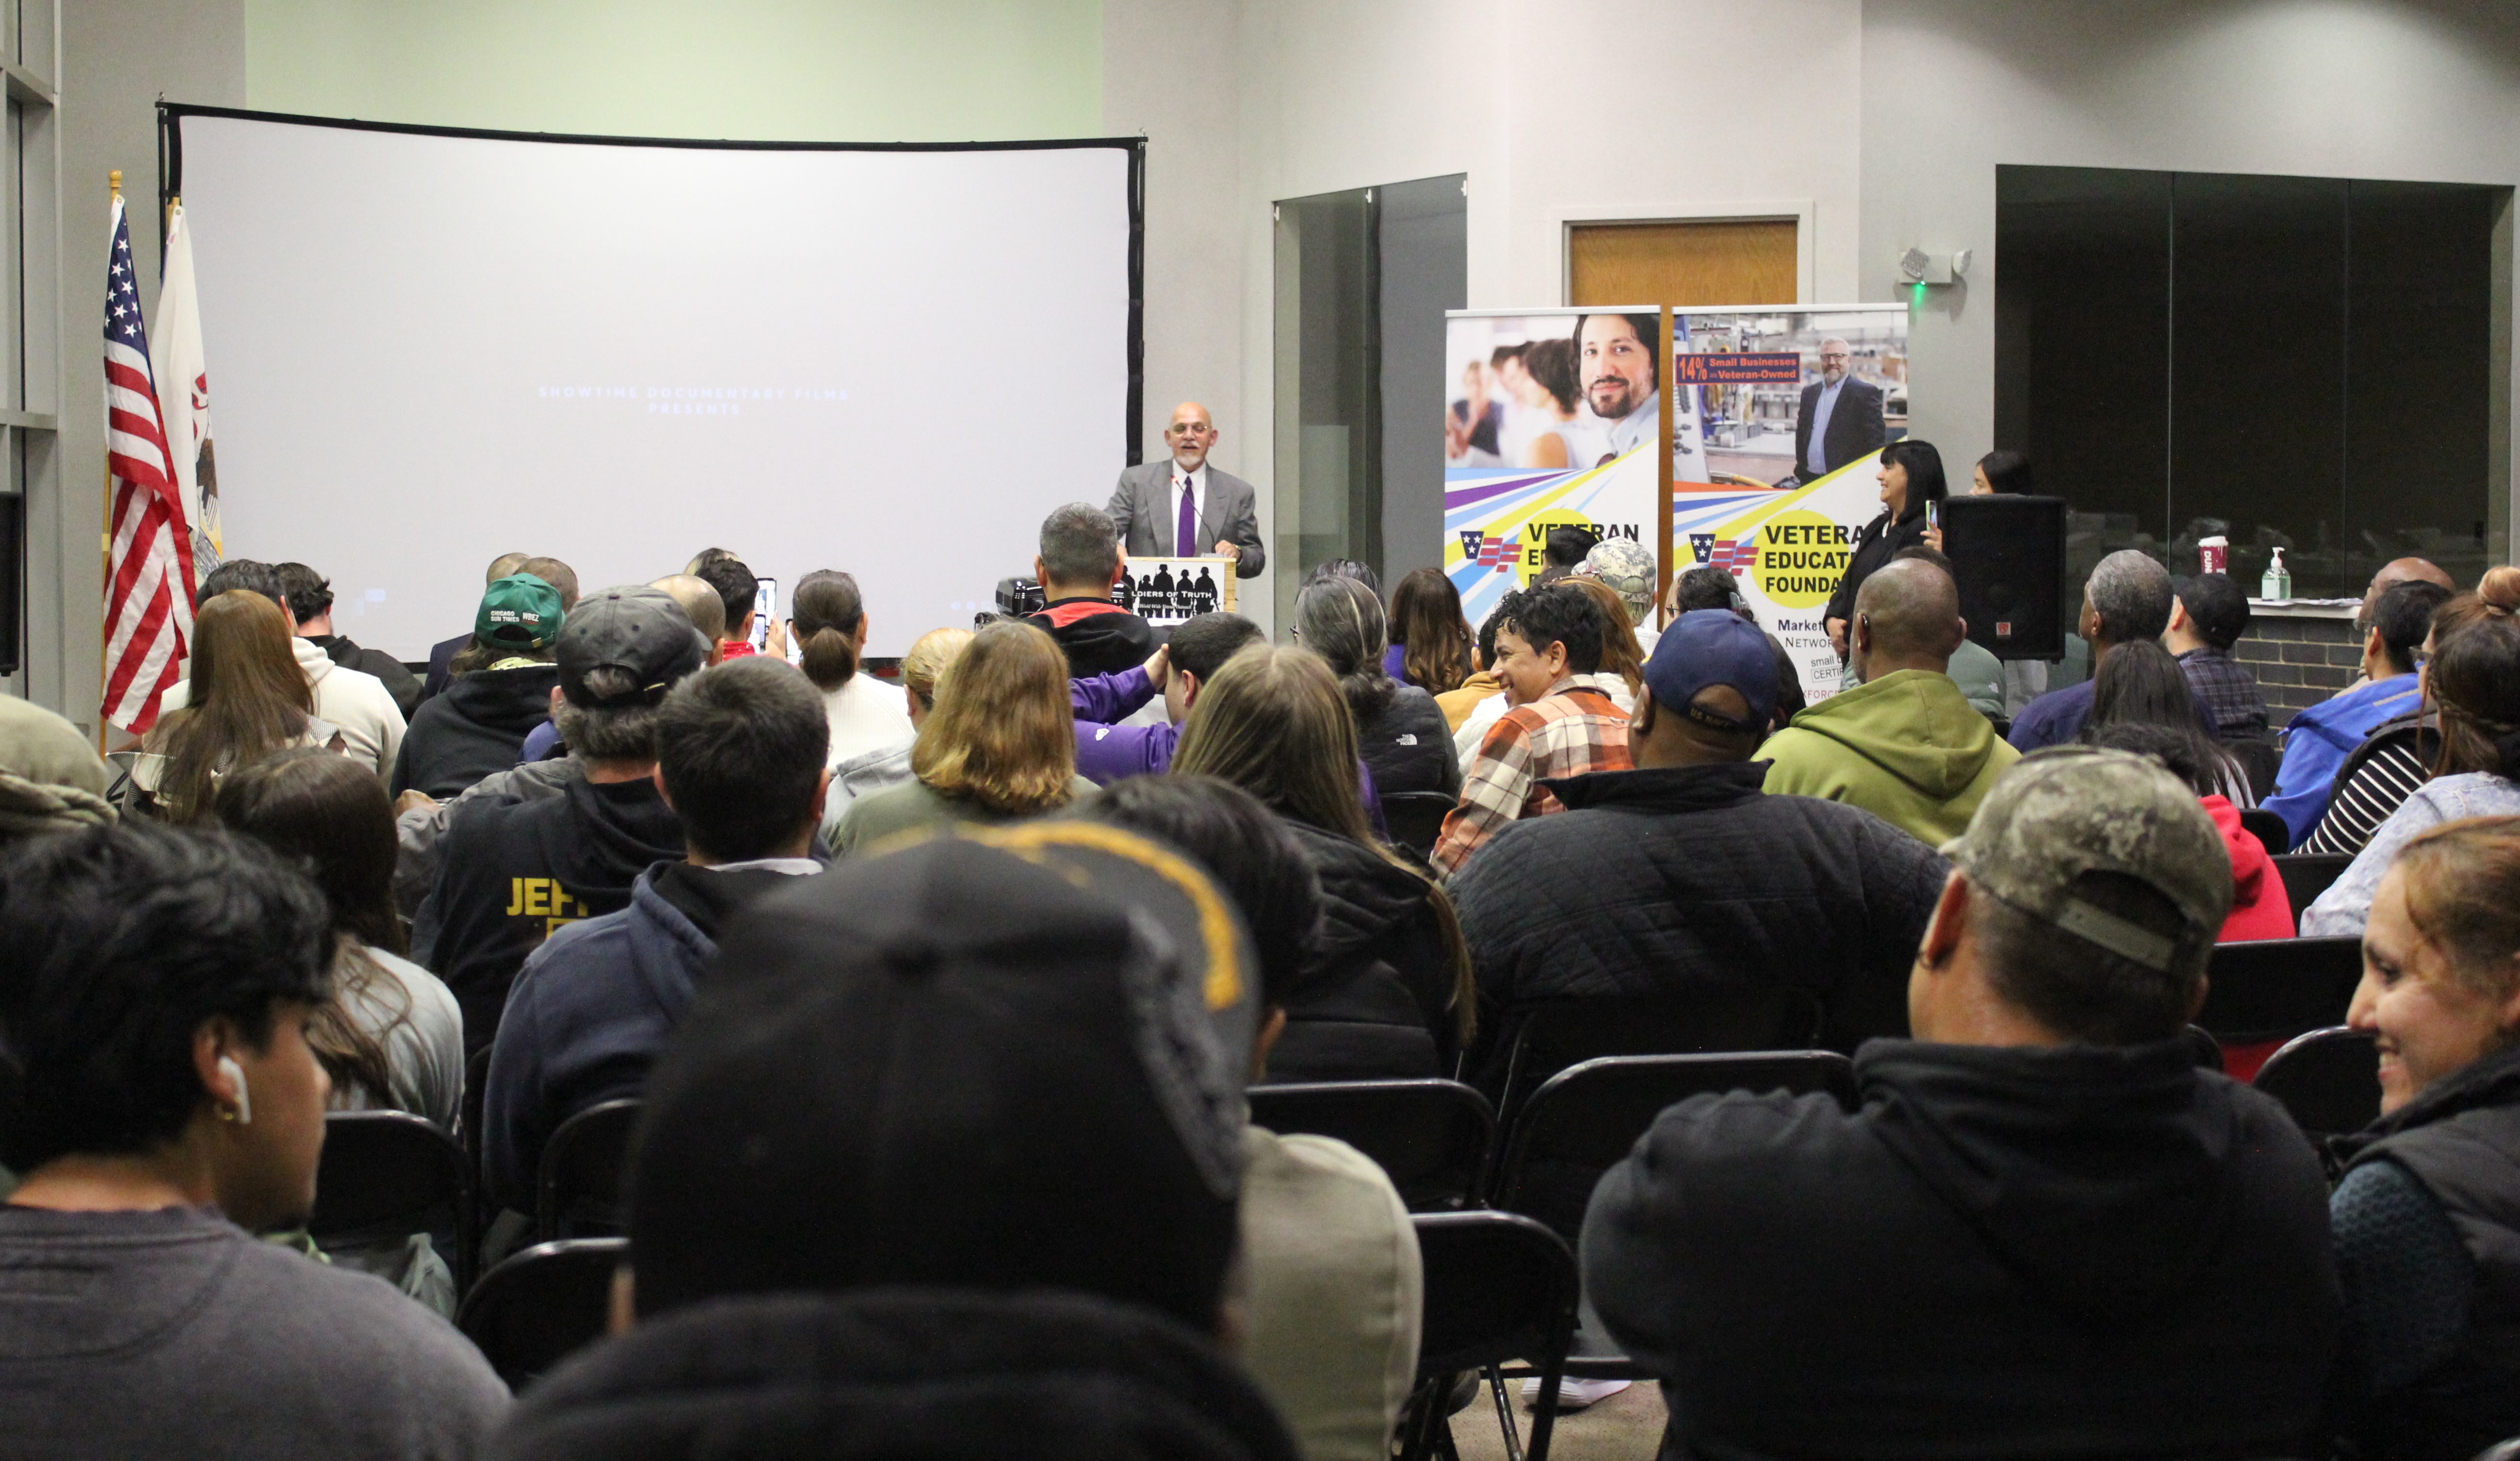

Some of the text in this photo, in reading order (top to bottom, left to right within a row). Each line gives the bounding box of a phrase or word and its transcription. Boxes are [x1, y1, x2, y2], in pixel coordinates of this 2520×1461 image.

[1680, 357, 1708, 380] 14%
[1710, 358, 1797, 367] Small Businesses
[1718, 369, 1796, 379] Veteran-Owned
[539, 387, 848, 400] SHOWTIME DOCUMENTARY FILMS
[648, 402, 741, 415] PRESENTS
[523, 612, 540, 622] WBEZ
[1811, 655, 1834, 667] small
